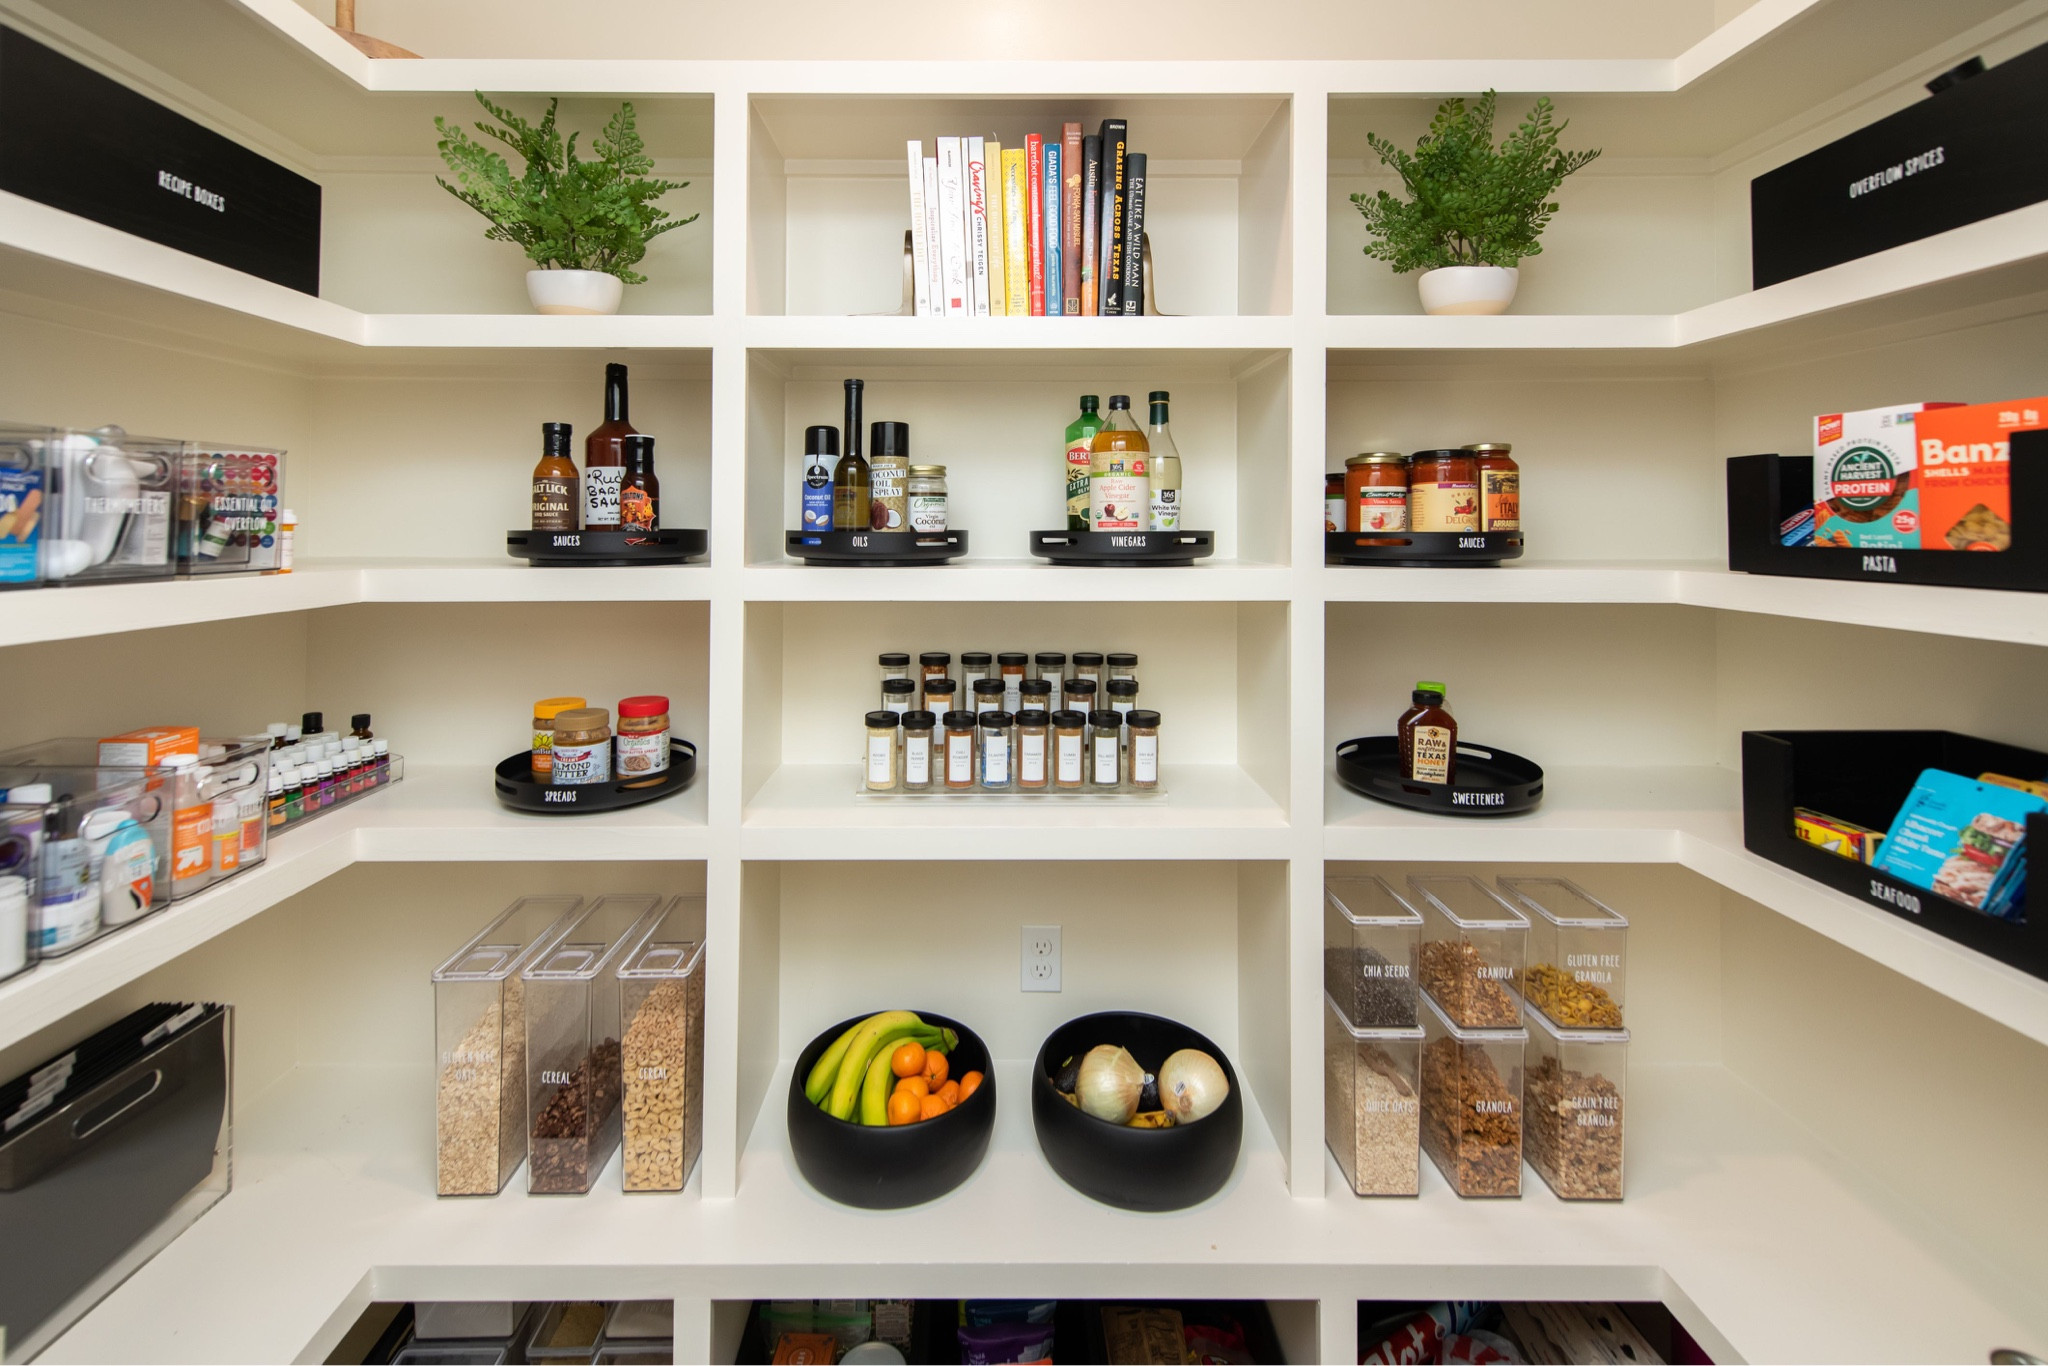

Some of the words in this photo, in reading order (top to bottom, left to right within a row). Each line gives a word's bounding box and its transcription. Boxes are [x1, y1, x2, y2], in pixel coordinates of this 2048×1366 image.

[1030, 141, 1040, 176] barefoot
[1048, 151, 1058, 184] GIADA'S
[1115, 141, 1124, 190] GRAZING
[1088, 159, 1098, 187] Austin
[1849, 163, 1904, 199] OVERFLOW
[1905, 146, 1945, 177] SPICES
[158, 170, 193, 199] RECIPE
[194, 186, 225, 213] BOXES
[968, 160, 987, 224] Cravings
[1135, 178, 1143, 196] EAT
[1048, 185, 1057, 203] FEEL
[1134, 199, 1142, 219] LIKE
[1048, 205, 1058, 227] GOOD
[1073, 210, 1081, 222] SAN
[1113, 194, 1123, 239] ACROSS
[1134, 223, 1142, 231] A
[1073, 223, 1081, 247] MIGUEL
[1132, 233, 1141, 259] WILD
[1112, 244, 1121, 280] TEXAS
[1033, 259, 1042, 279] that?
[1131, 263, 1140, 288] MAN
[1841, 461, 1882, 471] ANCIENT
[1924, 467, 1970, 478] SHELLS
[872, 470, 906, 479] OCONUT
[1840, 470, 1883, 480] HARVEST
[546, 483, 568, 496] LICK
[1069, 478, 1089, 492] EXTRA
[1834, 482, 1891, 494] PROTEIN
[874, 488, 901, 496] SPRAY
[84, 497, 169, 515] THERMOMETERS
[214, 497, 259, 512] ESSENTIAL
[260, 499, 275, 513] OIL
[532, 502, 569, 511] RIGINAL
[224, 517, 267, 532] OVERFLOW
[915, 517, 946, 525] Coconut
[553, 535, 580, 547] SAUCES
[852, 536, 868, 547] OILS
[1111, 536, 1146, 547] VINEGARS
[1458, 537, 1485, 548] SAUCES
[1862, 555, 1897, 573] PASTA
[1418, 738, 1442, 747] RAW
[1417, 752, 1446, 760] TEXAS
[1417, 758, 1446, 766] HONEY
[545, 790, 577, 802] SPREADS
[1452, 792, 1505, 806] SWEETENERS
[1869, 879, 1921, 914] SEAFOOD
[1567, 955, 1598, 967] GLUTEN
[1600, 955, 1621, 967] FREE
[1363, 965, 1383, 977] CHIA
[1385, 965, 1410, 977] SEEDS
[1477, 967, 1514, 979] GRANOLA
[1575, 970, 1613, 983] GRANOLA
[541, 1071, 570, 1084] CEREAL
[638, 1067, 667, 1080] CEREAL
[1393, 1101, 1414, 1113] OATS
[1475, 1101, 1512, 1113] GRANOLA
[1572, 1097, 1598, 1110] GRAIN
[1600, 1098, 1619, 1110] FREE
[1577, 1114, 1614, 1127] GRANOLA
